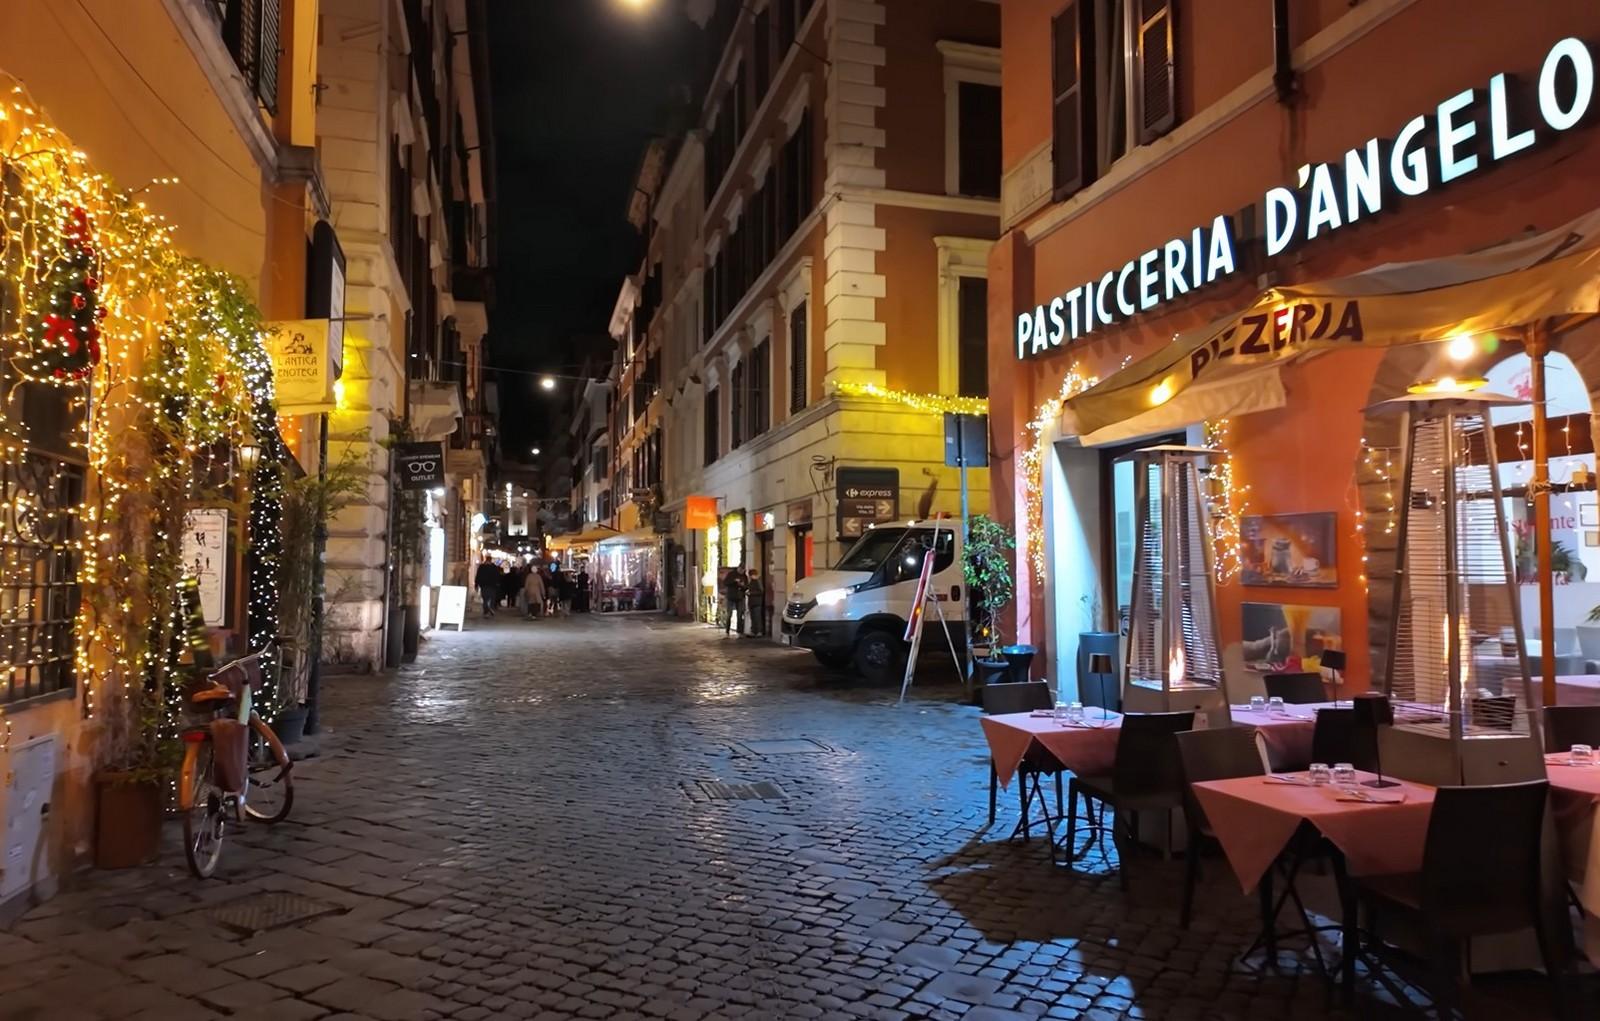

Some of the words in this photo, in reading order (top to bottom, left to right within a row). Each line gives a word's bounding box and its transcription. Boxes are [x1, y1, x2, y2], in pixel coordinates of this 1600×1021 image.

[1017, 215, 1235, 360] PASTICCERIA
[1265, 37, 1594, 257] D'ANGELO
[277, 367, 319, 377] ENOTECA
[410, 474, 435, 482] OUTLET
[859, 490, 892, 498] express
